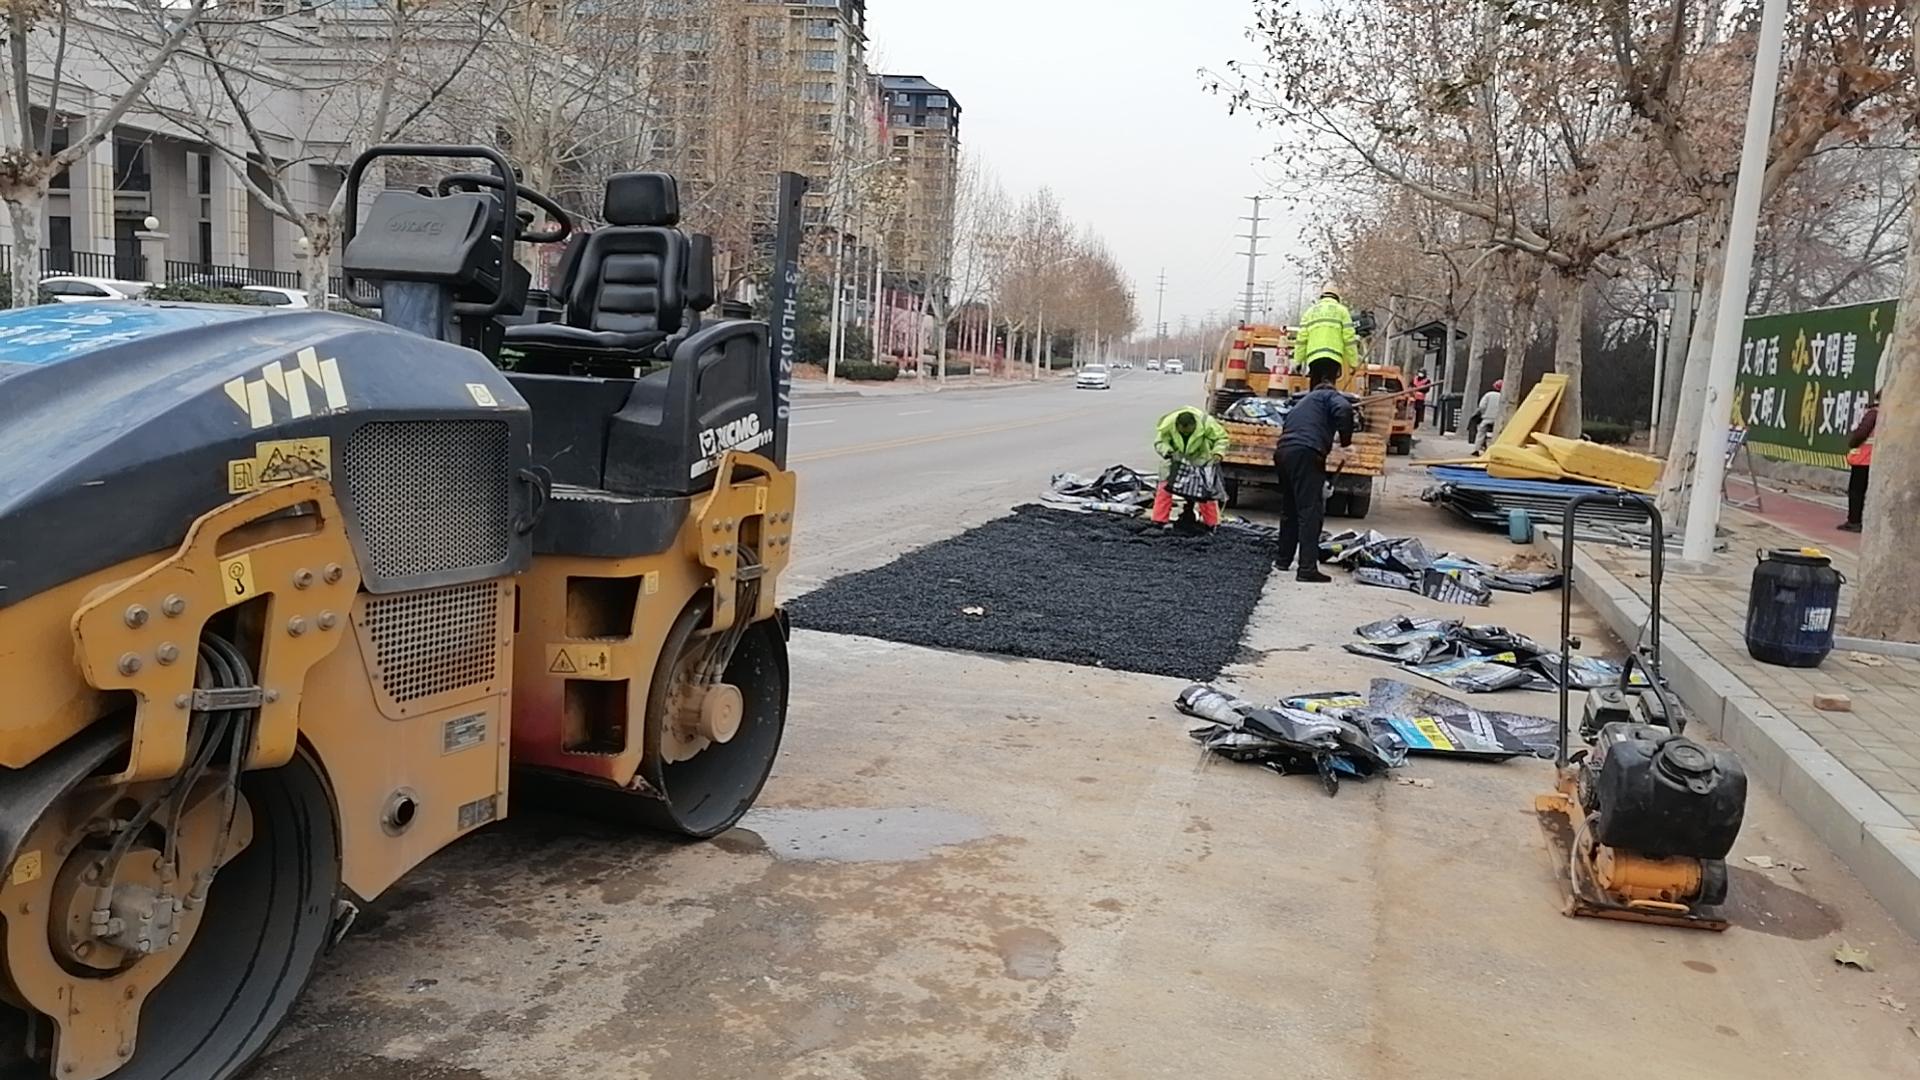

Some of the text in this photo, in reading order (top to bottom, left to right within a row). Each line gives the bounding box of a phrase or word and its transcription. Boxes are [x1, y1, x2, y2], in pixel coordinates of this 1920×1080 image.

[1741, 335, 1780, 377] 文明话
[715, 413, 760, 449] XCMG
